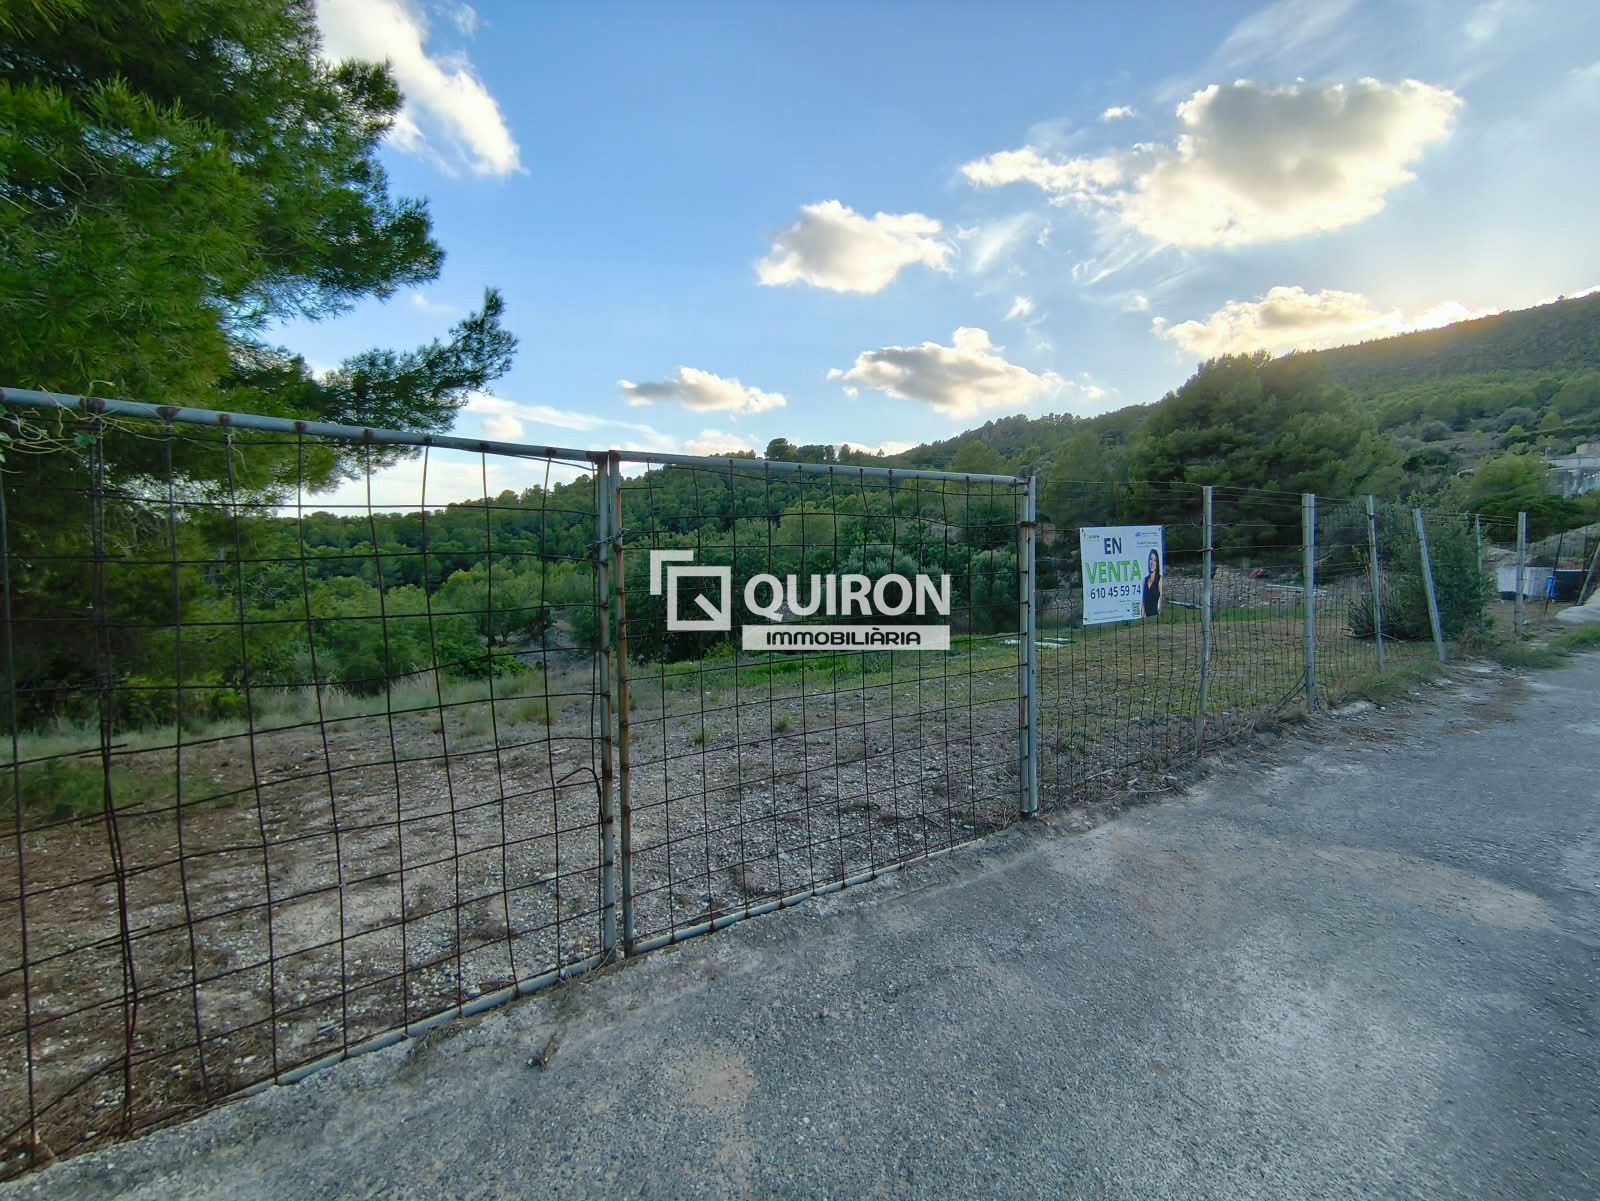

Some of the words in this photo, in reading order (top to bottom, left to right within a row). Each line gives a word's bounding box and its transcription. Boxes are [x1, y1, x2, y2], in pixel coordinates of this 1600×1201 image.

[1104, 537, 1122, 554] EN
[1085, 560, 1142, 584] VENTA
[1090, 587, 1106, 600] 610
[1108, 586, 1119, 598] 45
[1120, 585, 1130, 597] 59
[1131, 584, 1141, 595] 74
